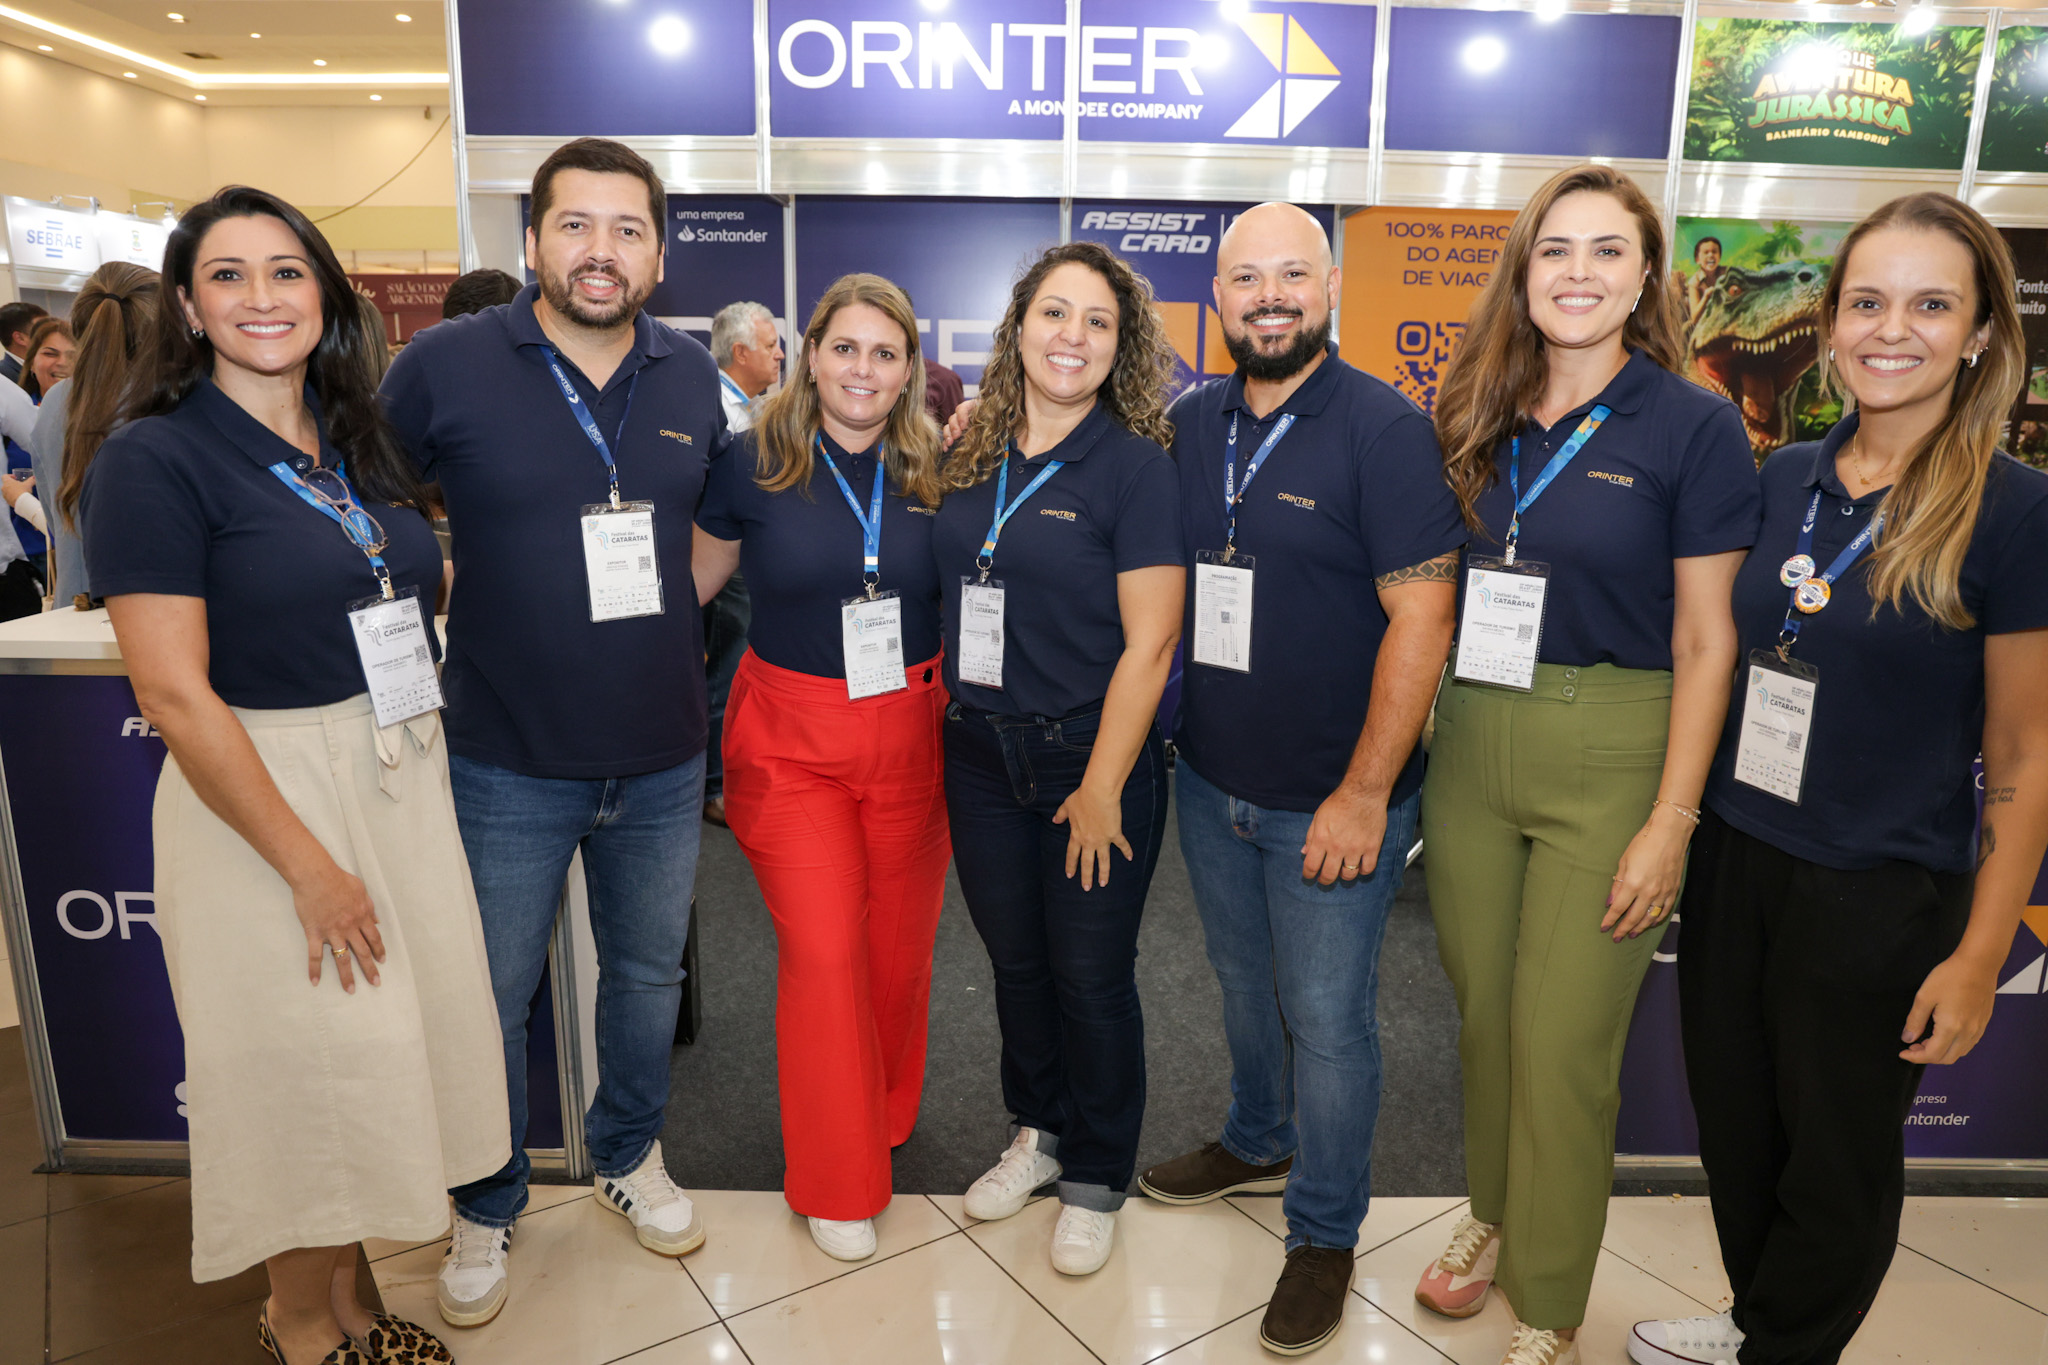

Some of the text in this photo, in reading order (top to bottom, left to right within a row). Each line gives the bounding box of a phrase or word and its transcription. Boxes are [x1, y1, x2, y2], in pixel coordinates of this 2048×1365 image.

[778, 19, 1204, 96] ORINTER
[1008, 99, 1022, 115] A
[1111, 102, 1204, 120] COMPANY
[1748, 88, 1912, 135] JURÁSSICA
[1766, 126, 1890, 146] BALNEÁRIO CAMBORIÚ
[676, 211, 745, 222] uma empresa
[1080, 211, 1206, 232] ASSIST
[26, 229, 83, 250] SEBRAE
[697, 228, 768, 242] Santander
[1385, 222, 1511, 240] 100% PARC
[1119, 233, 1212, 254] CARD
[1407, 246, 1502, 263] DO AGEN
[1403, 270, 1493, 287] DE VIAG
[387, 293, 445, 305] ARGENTIN
[552, 363, 575, 396] ORINTER
[659, 429, 693, 443] ORINTER
[1265, 417, 1290, 447] ORINTER
[1226, 462, 1235, 495] ORINTER
[1587, 470, 1635, 485] ORINTER
[1277, 492, 1316, 508] ORINTER
[1805, 489, 1823, 523] ORINTER
[1040, 508, 1077, 519] ORINTER
[611, 535, 648, 544] CATARATAS
[1493, 597, 1535, 609] CATARATAS
[383, 621, 420, 637] CATARATAS
[864, 619, 897, 629] CATARATAS
[1770, 698, 1806, 716] CATARATAS
[1913, 1095, 1947, 1106] presa
[1904, 1113, 1970, 1125] ntander
